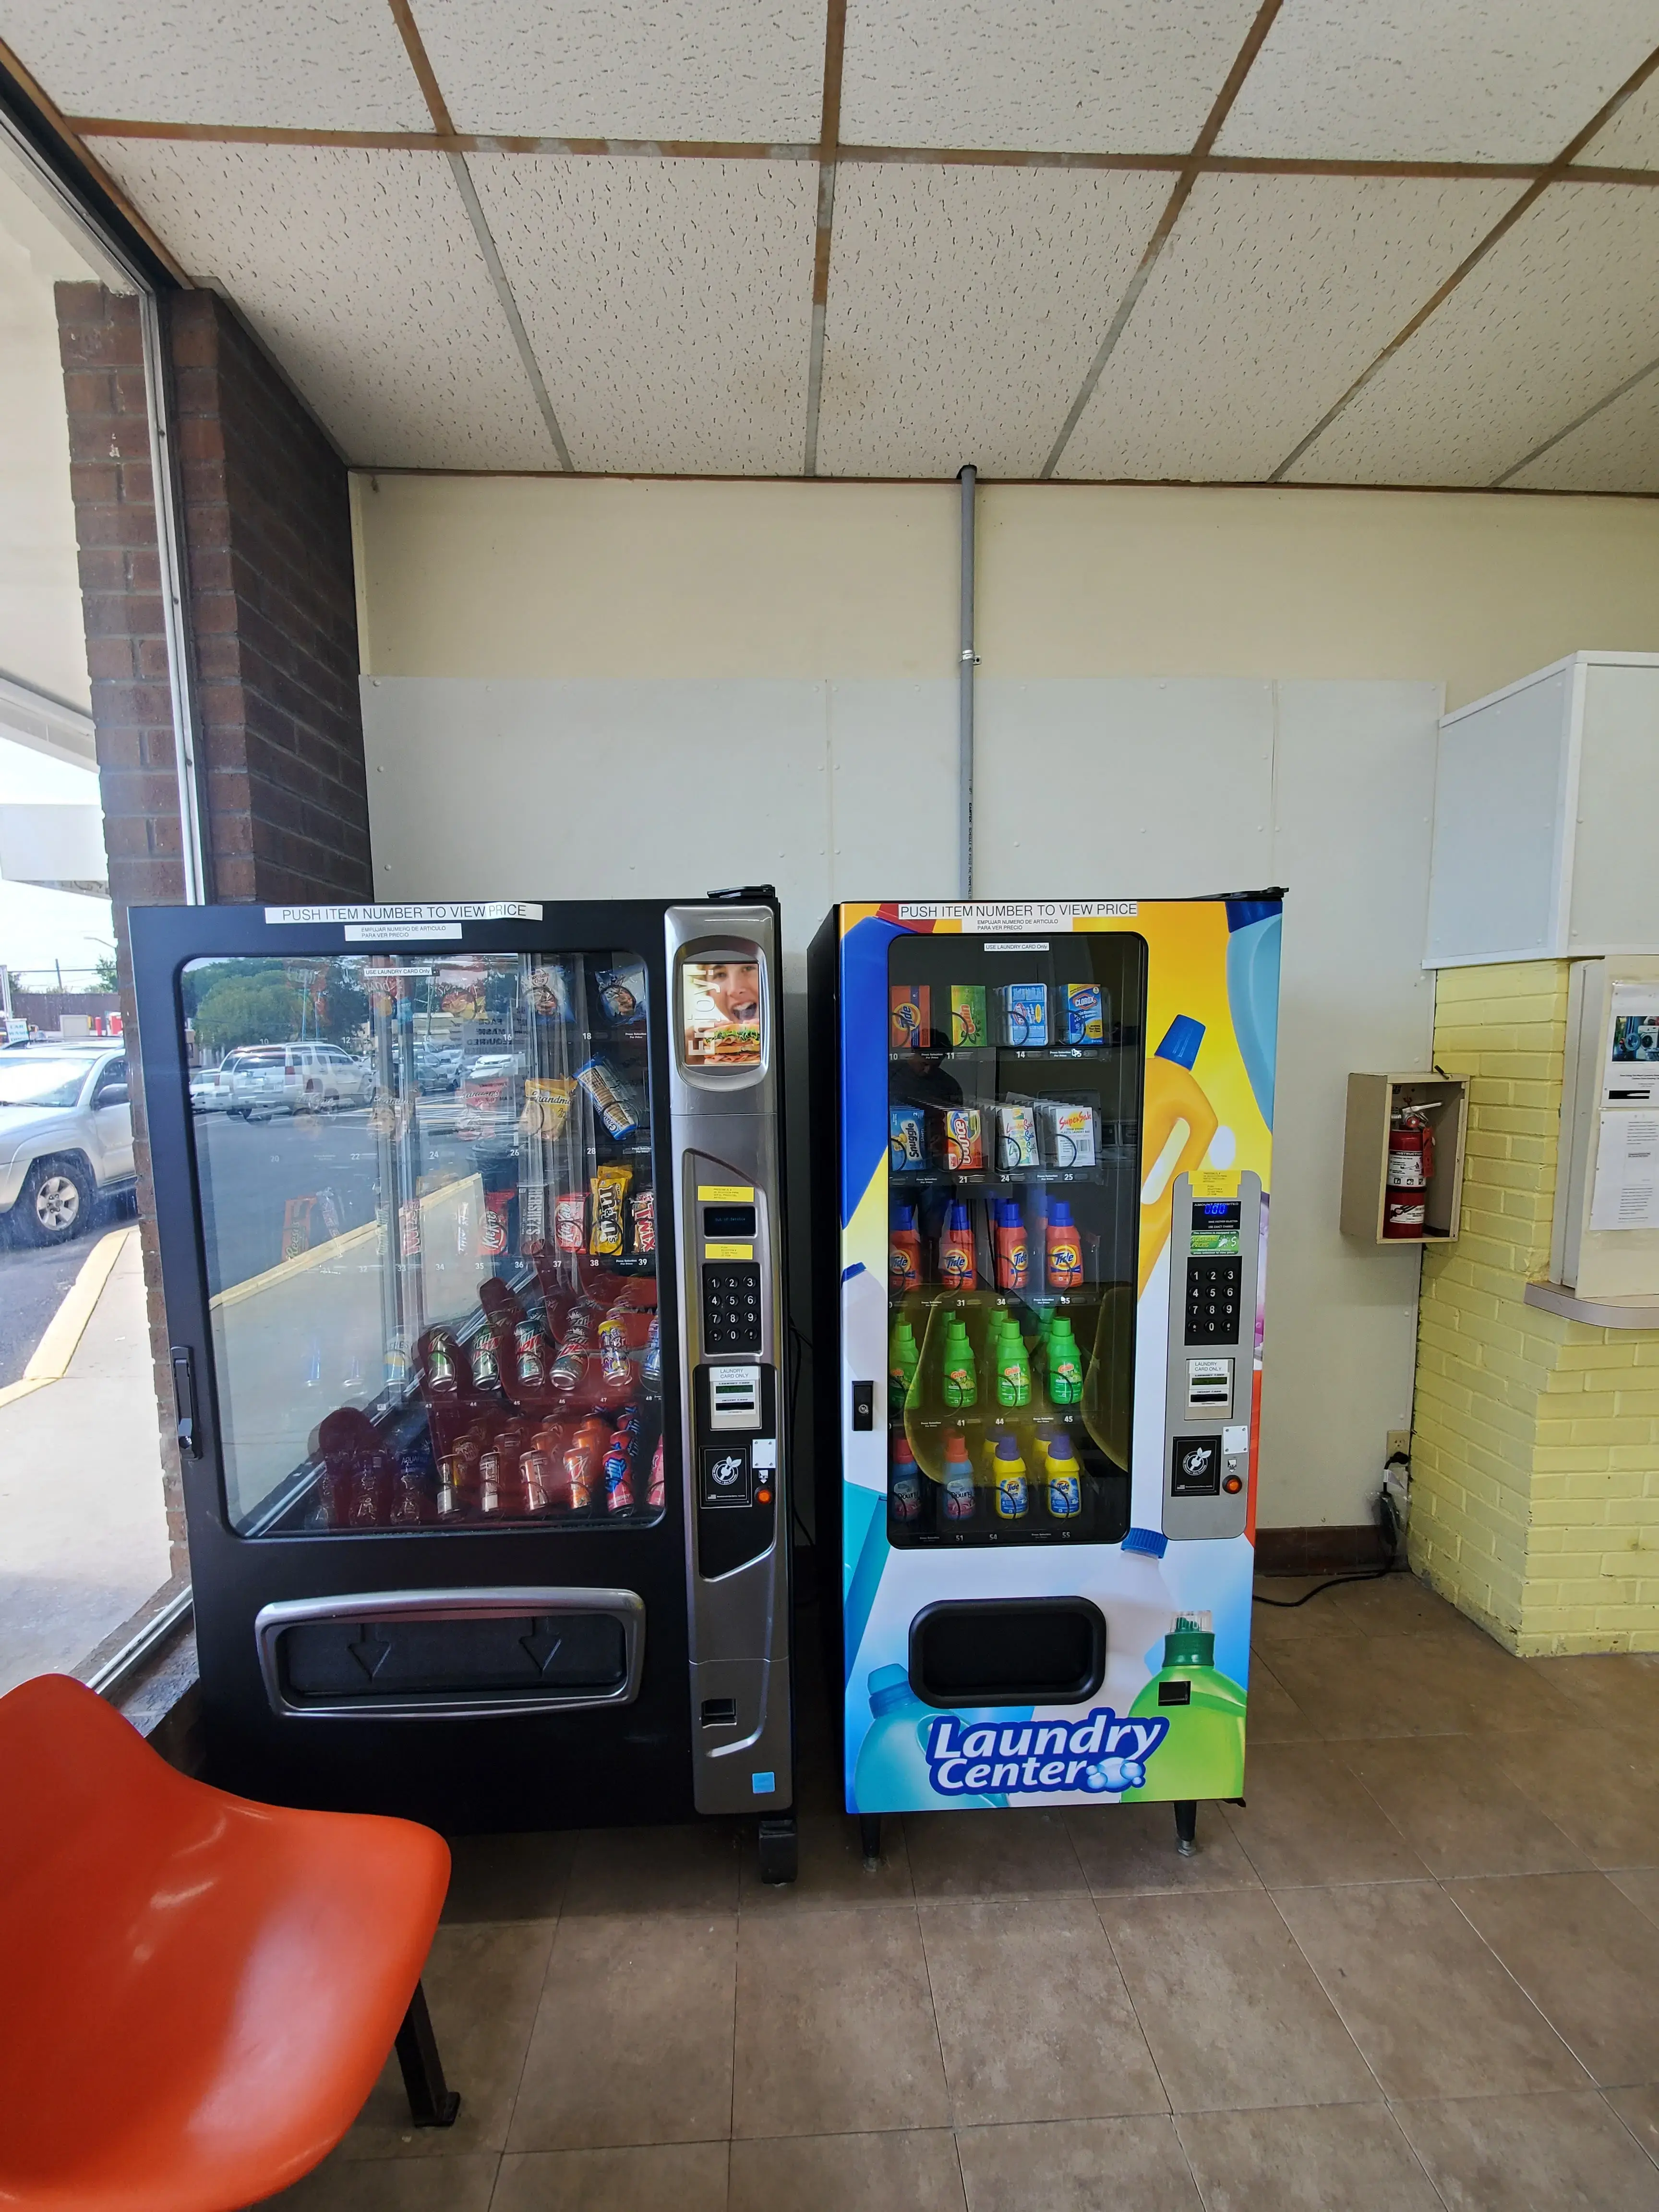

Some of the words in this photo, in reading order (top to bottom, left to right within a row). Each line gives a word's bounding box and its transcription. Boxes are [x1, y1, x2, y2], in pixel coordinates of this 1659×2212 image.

[282, 909, 323, 921] PUSH
[325, 908, 359, 920] ITEM
[363, 907, 423, 919] NUMBER
[427, 906, 446, 918] TO
[450, 905, 485, 918] VIEW
[488, 904, 527, 917] PRICE
[901, 906, 937, 917] PUSH
[941, 906, 973, 917] ITEM
[976, 905, 1033, 916] NUMBER
[1037, 904, 1055, 915] TO
[1059, 904, 1093, 915] VIEW
[1097, 903, 1137, 915] PRICE
[1075, 996, 1094, 1007] CLOROX
[687, 969, 721, 1056] Enjoy!
[899, 1005, 916, 1029] Tide
[1059, 1111, 1092, 1130] SuperSak
[905, 1122, 919, 1158] Snuggle
[955, 1120, 971, 1164] bounce
[635, 1204, 656, 1252] TWIX
[890, 1256, 908, 1267] Tide
[942, 1256, 965, 1269] Tide
[1014, 1252, 1027, 1266] Tide
[1054, 1252, 1074, 1265] Tide
[1194, 1272, 1199, 1280] 1
[1227, 1271, 1233, 1279] 3
[711, 1279, 716, 1287] 1
[729, 1279, 734, 1287] 2
[747, 1278, 753, 1286] 3
[1192, 1289, 1198, 1297] 4
[1210, 1288, 1215, 1297] 5
[1227, 1288, 1233, 1296] 6
[711, 1297, 717, 1305] 4
[729, 1297, 735, 1305] 5
[747, 1296, 753, 1304] 6
[1209, 1306, 1215, 1314] 8
[1226, 1305, 1232, 1313] 9
[712, 1314, 718, 1322] 7
[730, 1314, 735, 1322] 8
[748, 1313, 753, 1322] 9
[1209, 1323, 1214, 1331] 0
[731, 1331, 736, 1339] 0
[951, 1370, 966, 1380] Gain
[1007, 1483, 1019, 1491] Tide
[1057, 1483, 1070, 1491] Tide
[898, 1491, 918, 1500] Downy
[951, 1491, 972, 1499] Downy
[934, 1714, 1162, 1761] Laundry
[937, 1757, 1087, 1789] Center
